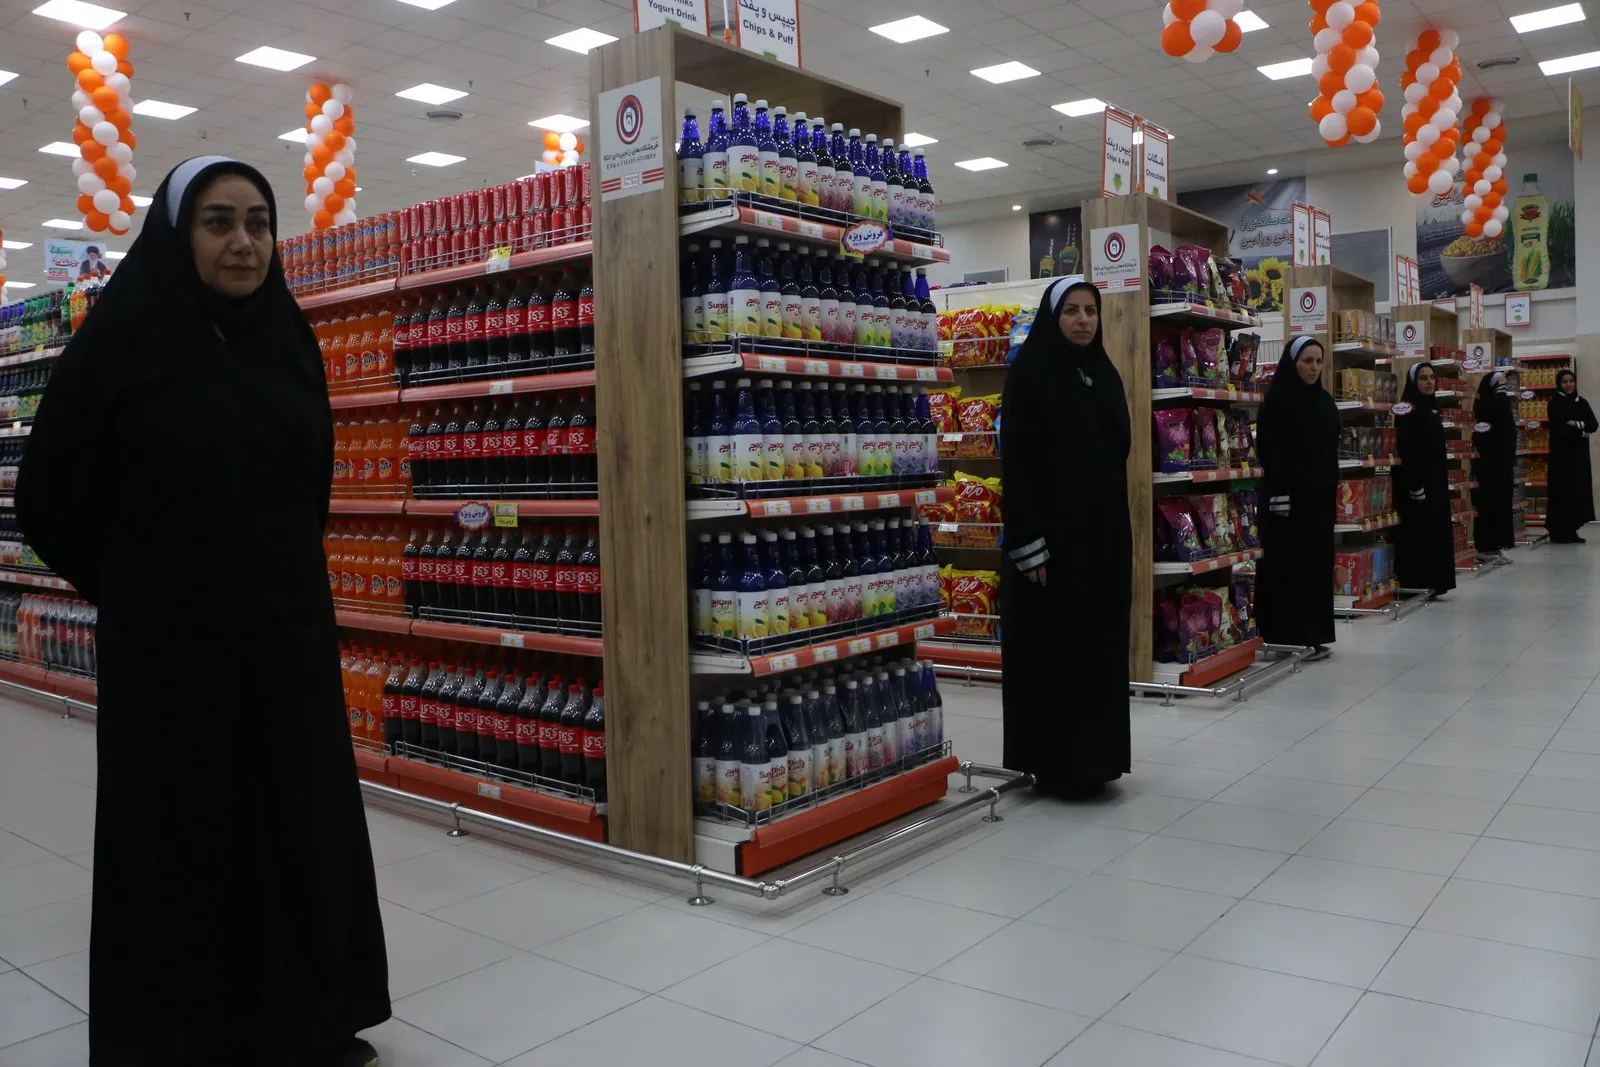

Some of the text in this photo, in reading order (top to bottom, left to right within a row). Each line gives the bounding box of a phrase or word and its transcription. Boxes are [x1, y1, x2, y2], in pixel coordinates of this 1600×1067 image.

[648, 0, 698, 22] Yogurt Drink
[761, 8, 766, 18] و
[768, 12, 796, 32] چیپس
[743, 19, 794, 45] Chips & Puff
[1146, 168, 1166, 182] Chocolate
[848, 230, 883, 242] فروش ویژه
[1272, 228, 1292, 246] وغن
